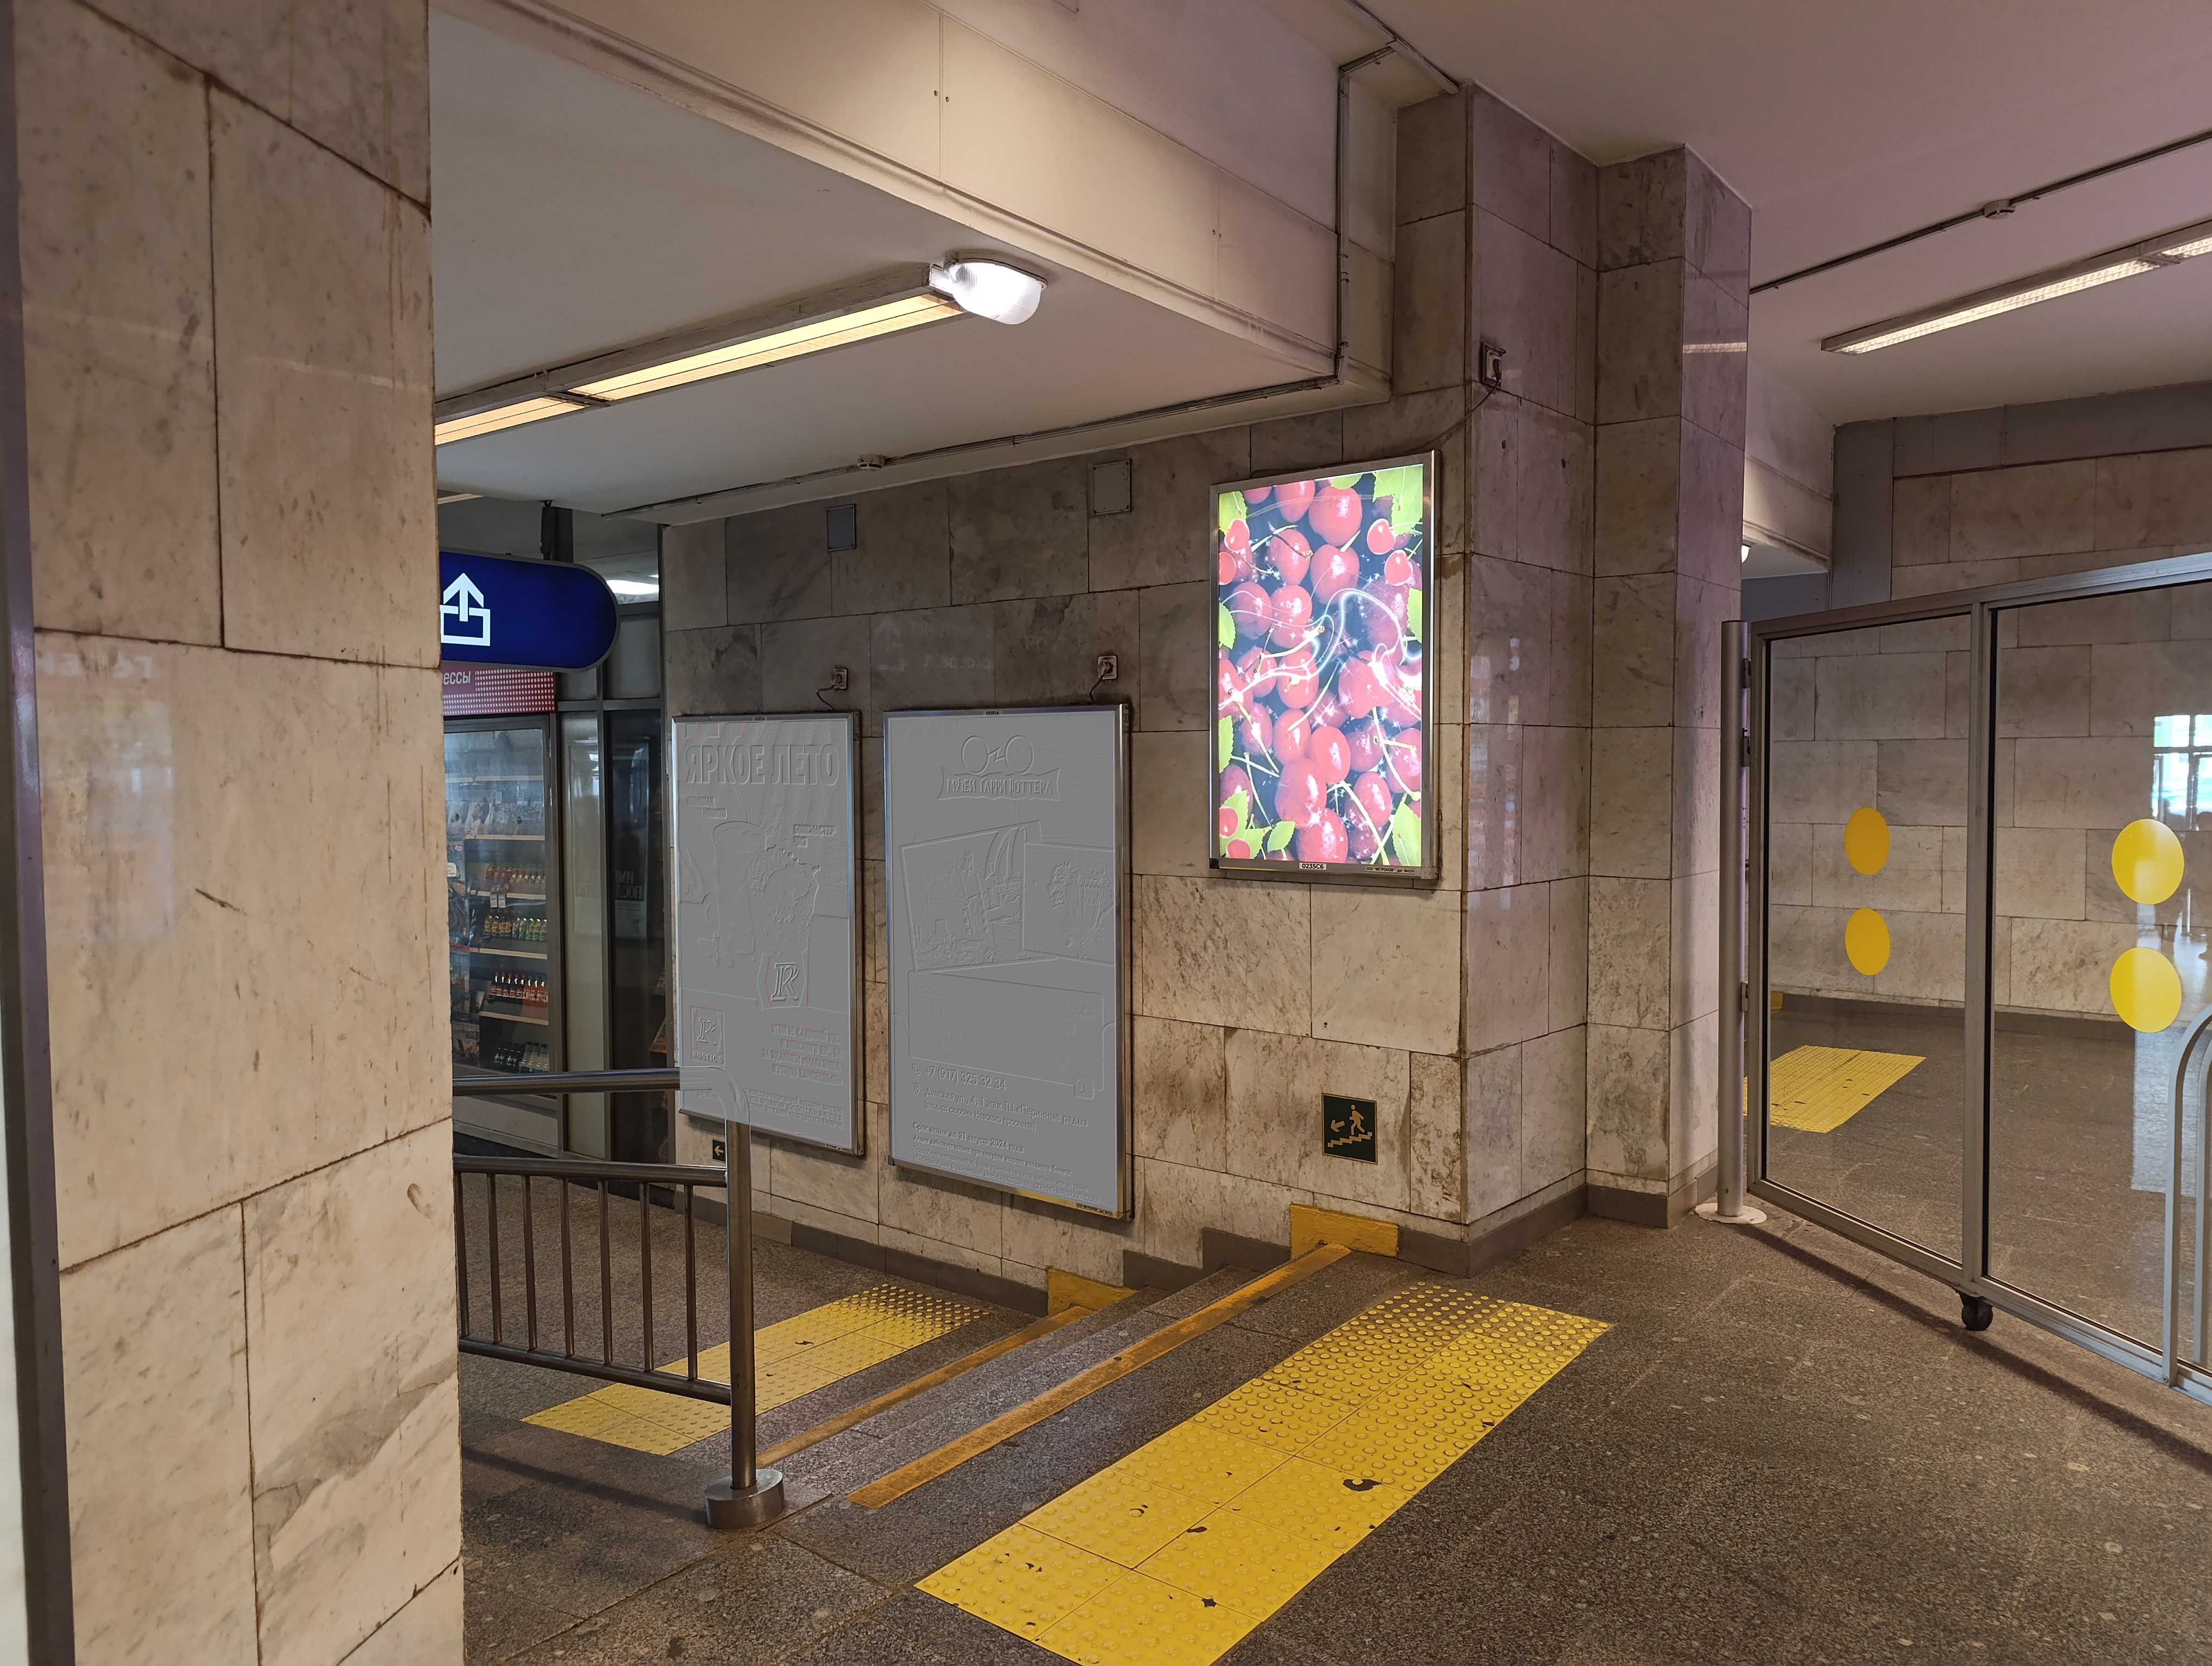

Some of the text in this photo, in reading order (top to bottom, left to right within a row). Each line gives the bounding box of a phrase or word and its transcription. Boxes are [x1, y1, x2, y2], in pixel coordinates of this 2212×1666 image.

[686, 744, 840, 786] ЯРКОЕ ЛЕТО
[947, 777, 1052, 796] МУЗЕЙ ГАРРИ ПОТТЕРА
[924, 1066, 1007, 1091] +7 (917) 325 32 34
